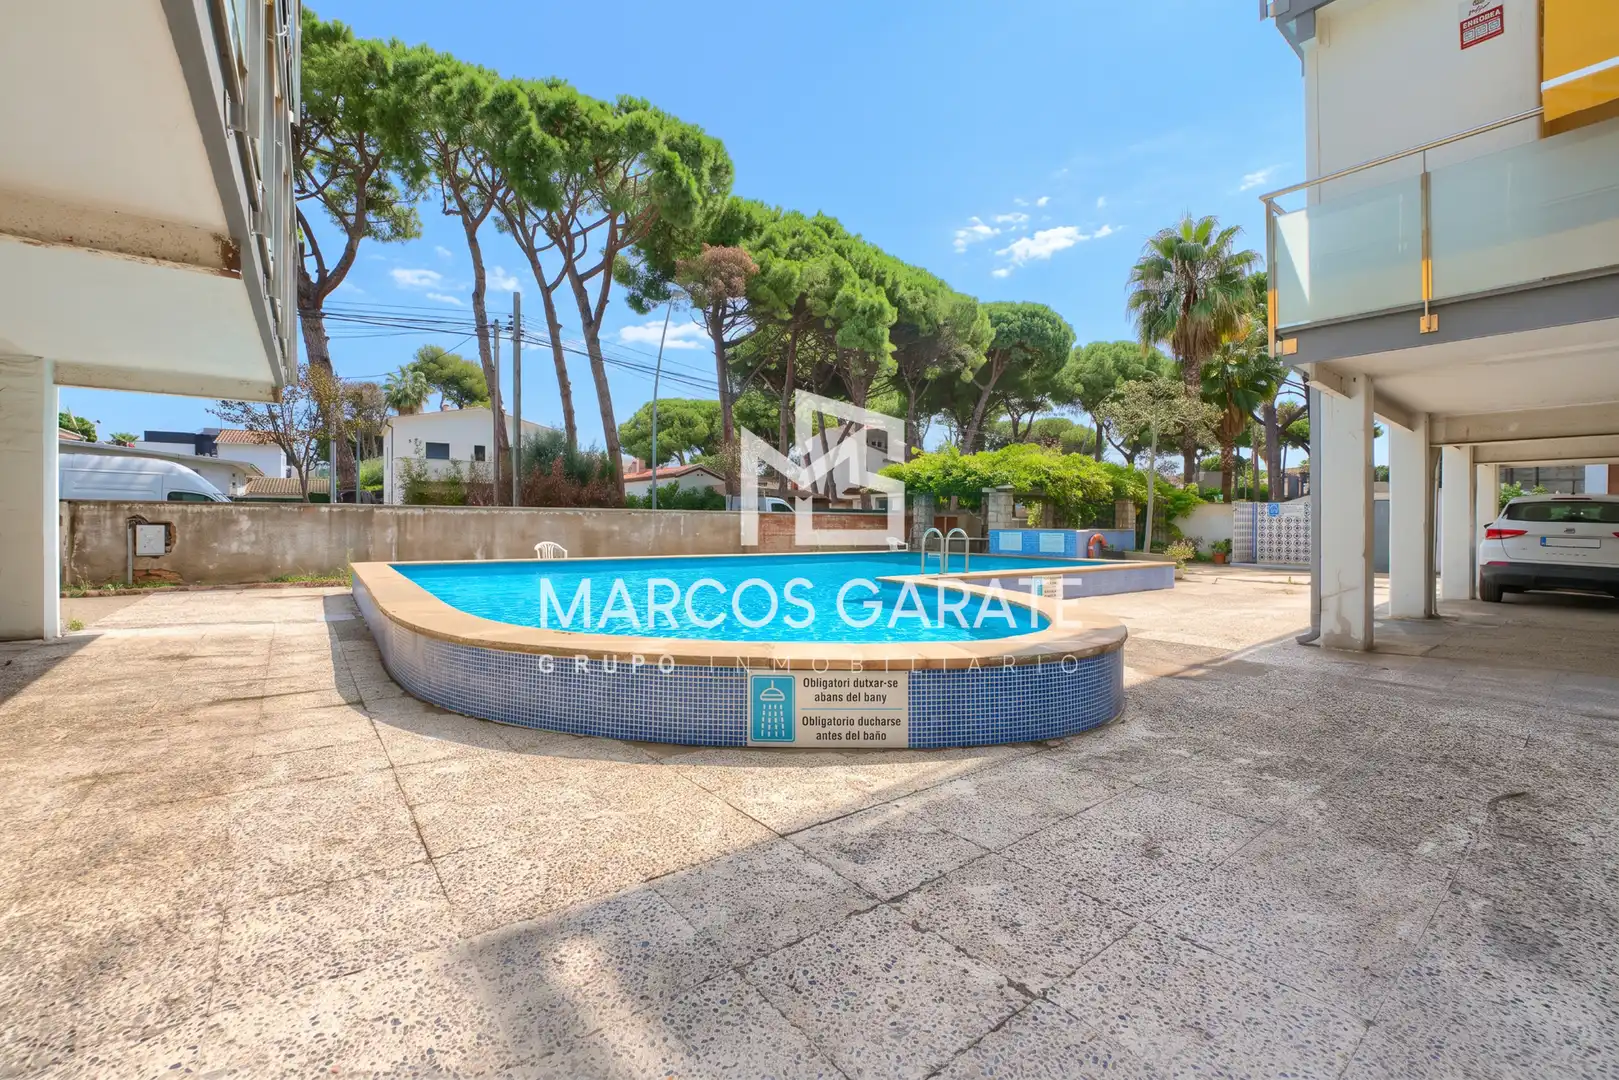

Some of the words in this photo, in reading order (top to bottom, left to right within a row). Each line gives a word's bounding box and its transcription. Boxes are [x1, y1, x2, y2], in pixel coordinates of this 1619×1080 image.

[803, 677, 850, 689] Obligatori
[853, 677, 899, 688] dutxar-se
[814, 692, 843, 702] abans
[846, 692, 861, 702] del
[864, 692, 887, 704] bany
[801, 715, 855, 728] Obligatorio
[858, 716, 901, 726] ducharse
[816, 730, 843, 740] antes
[845, 730, 860, 740] del
[863, 730, 887, 740] baño
